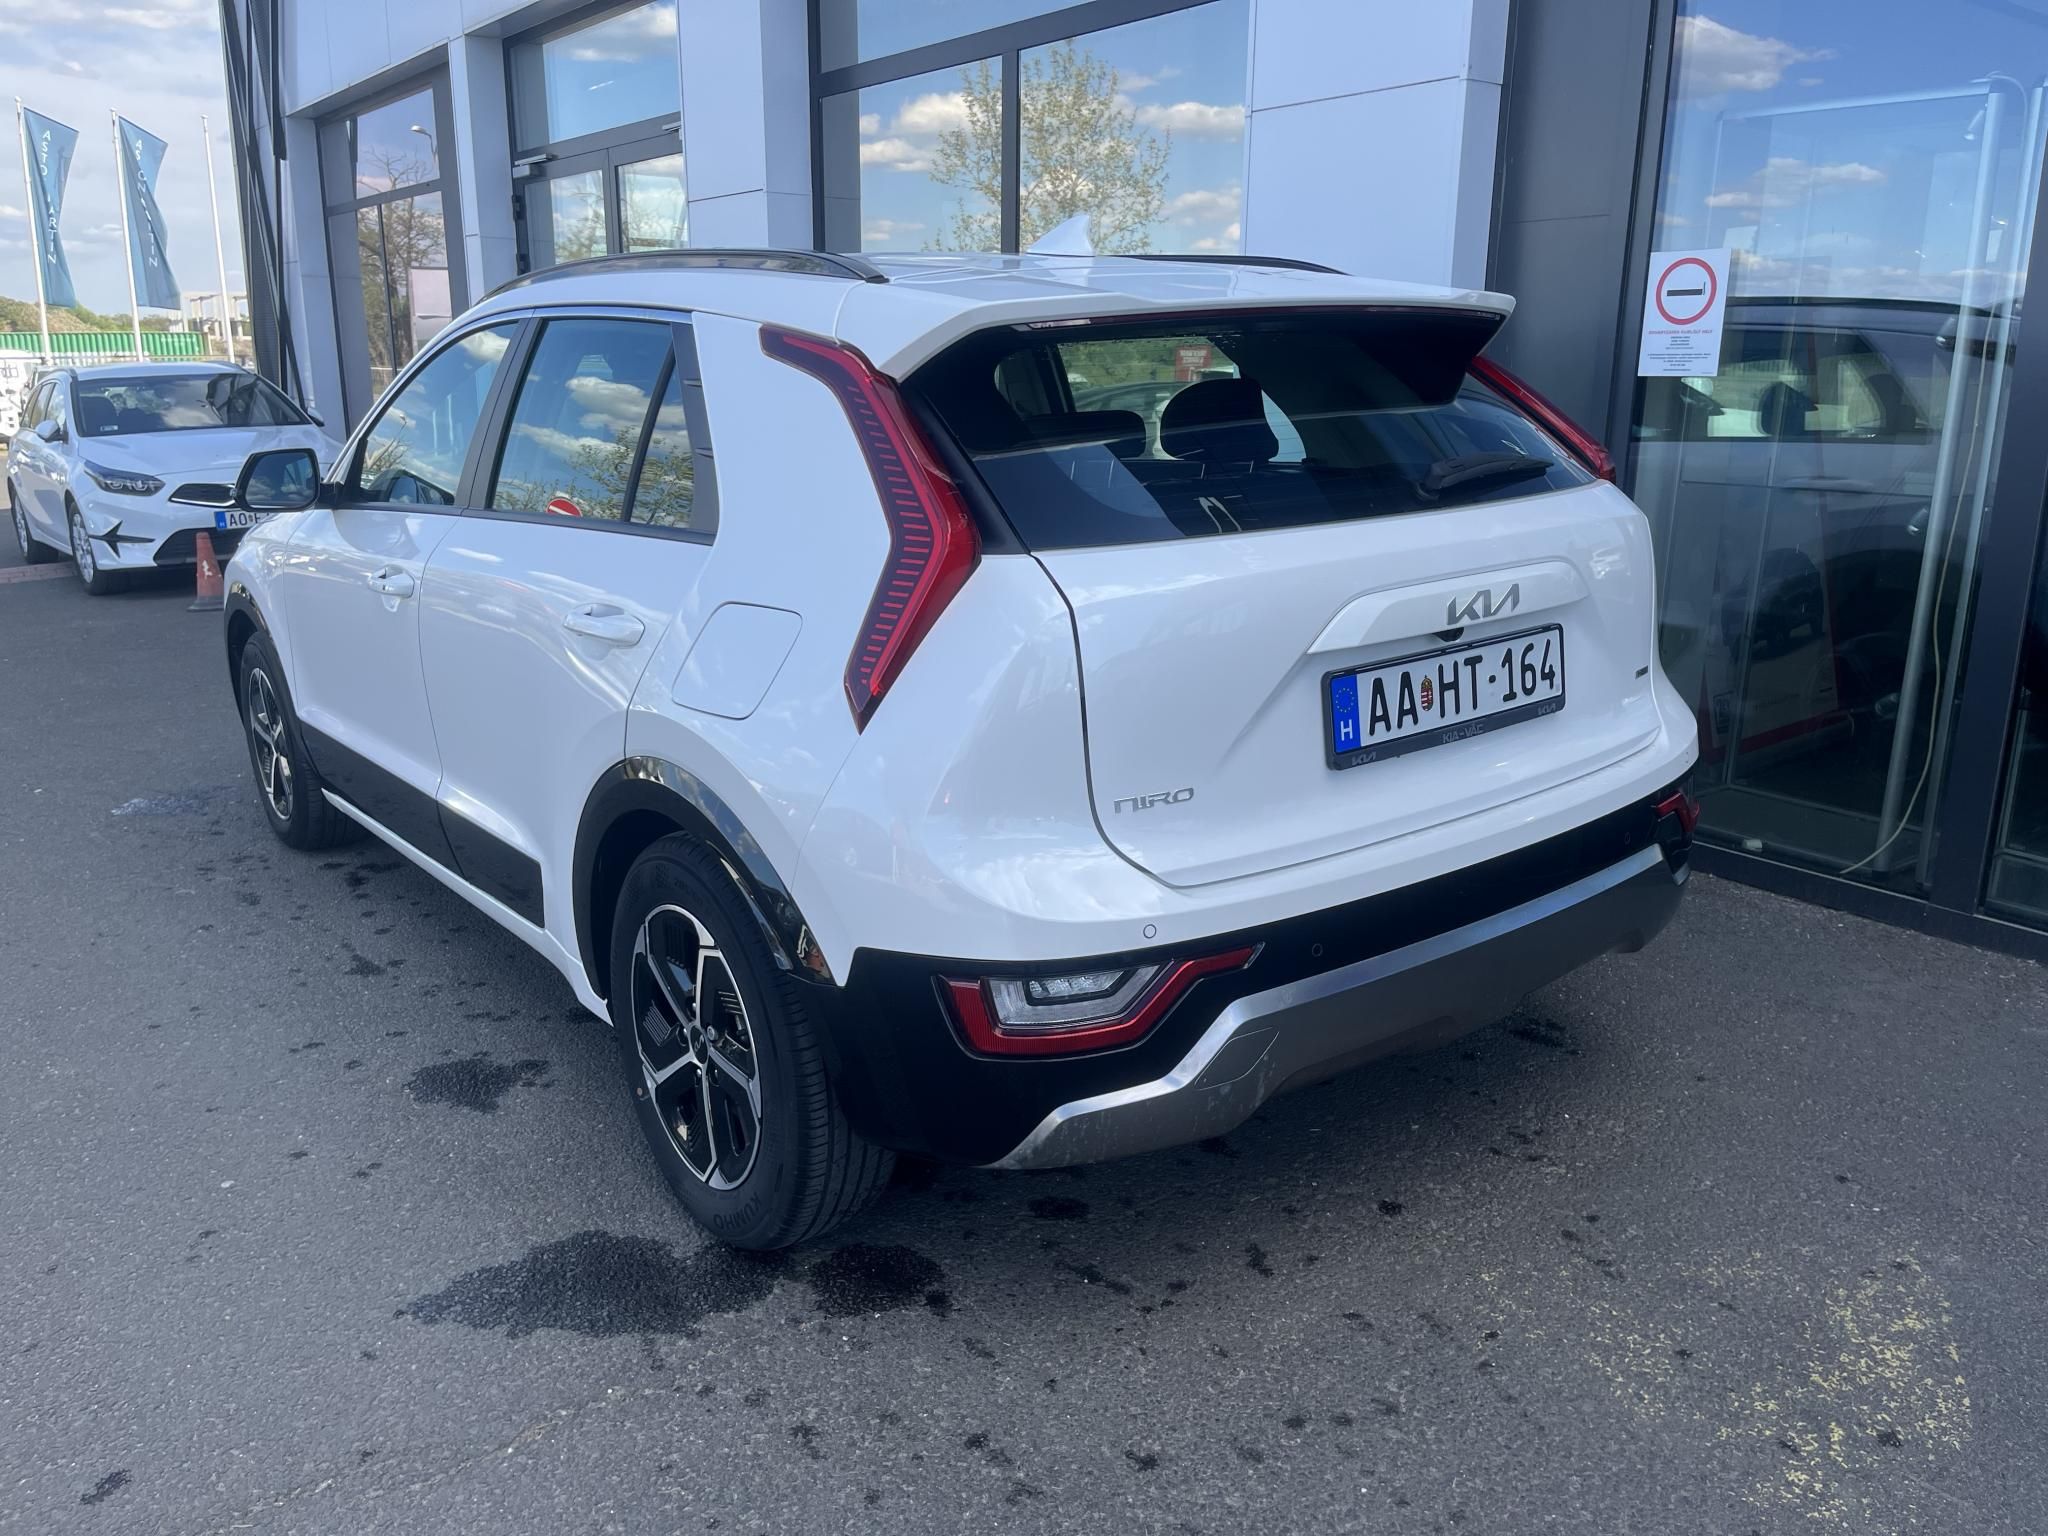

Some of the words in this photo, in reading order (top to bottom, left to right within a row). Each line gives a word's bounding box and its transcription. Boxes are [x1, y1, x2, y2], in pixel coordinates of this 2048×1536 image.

[40, 129, 51, 177] ASTO
[135, 139, 147, 193] ASON
[1446, 583, 1520, 625] KIA
[1340, 719, 1354, 742] H
[1113, 787, 1195, 814] NIRO
